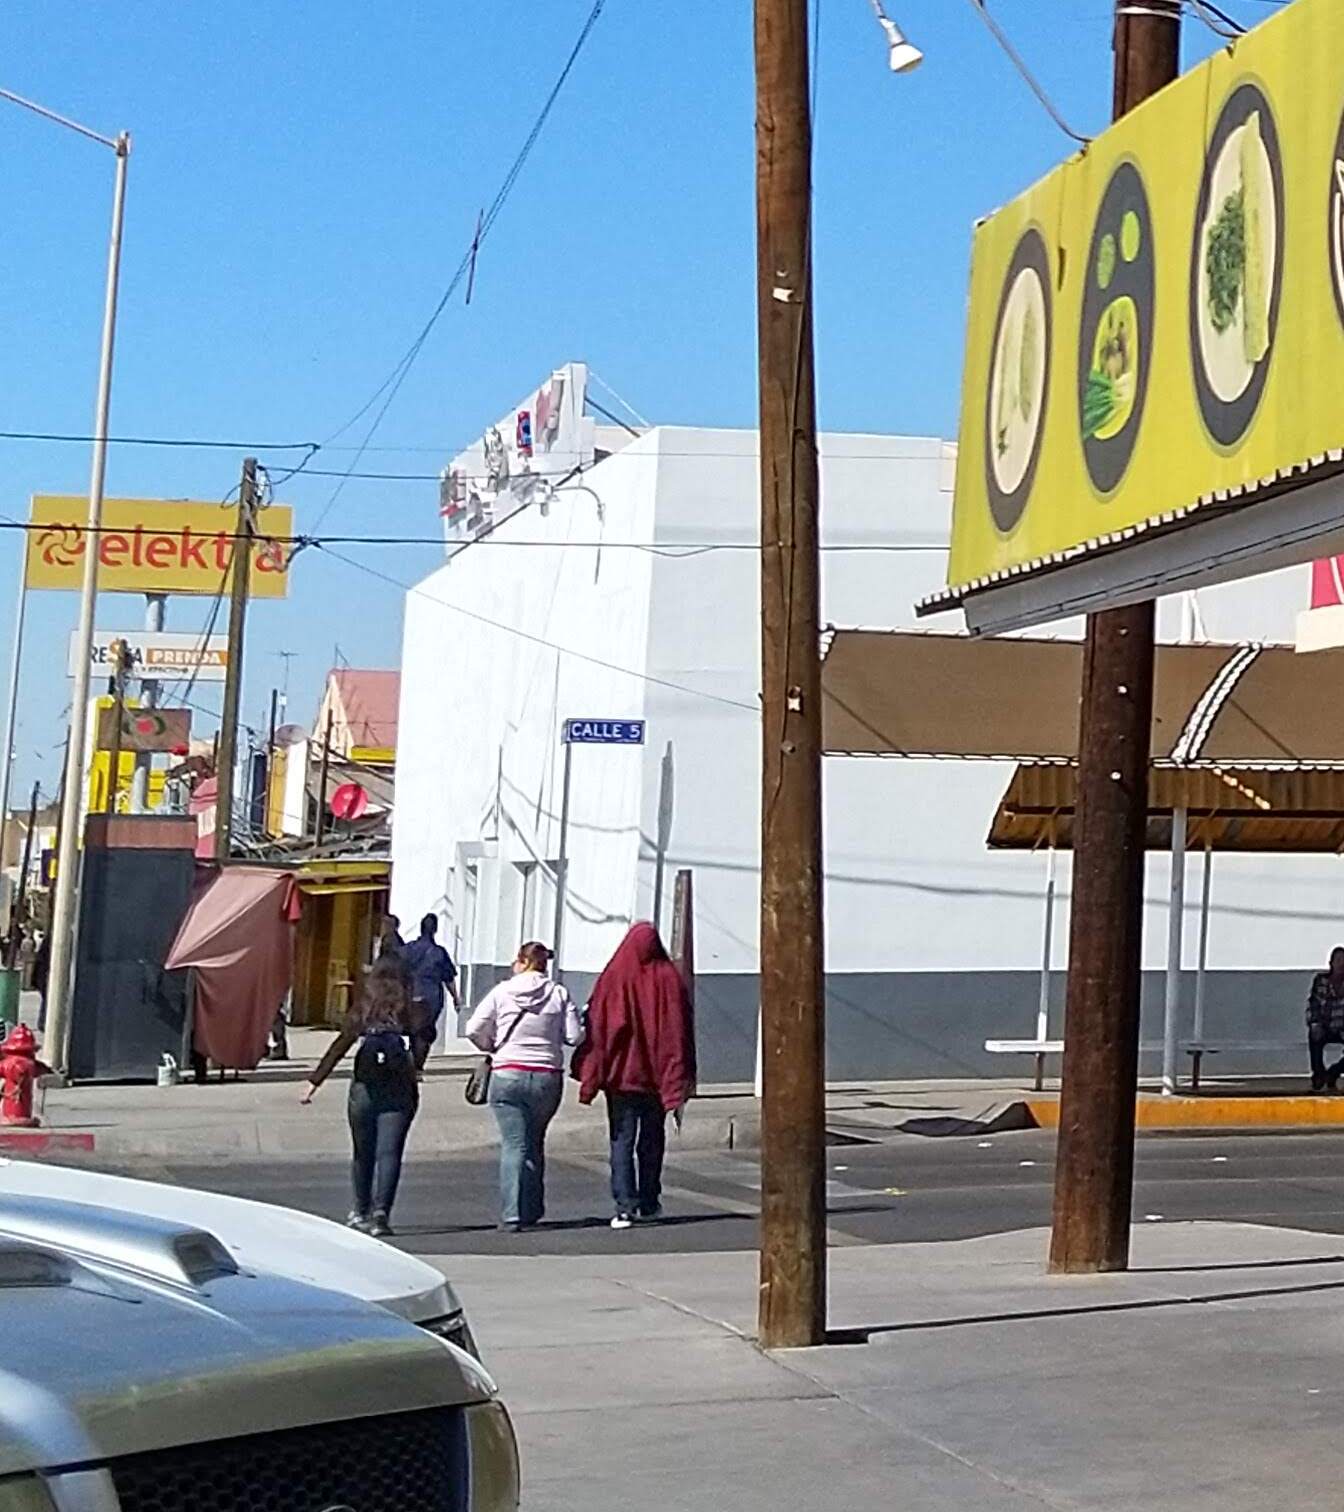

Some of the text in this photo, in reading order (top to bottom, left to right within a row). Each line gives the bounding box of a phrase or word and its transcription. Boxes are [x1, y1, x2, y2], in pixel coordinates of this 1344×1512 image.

[99, 524, 286, 572] elekta
[571, 722, 640, 738] CALLE 5
